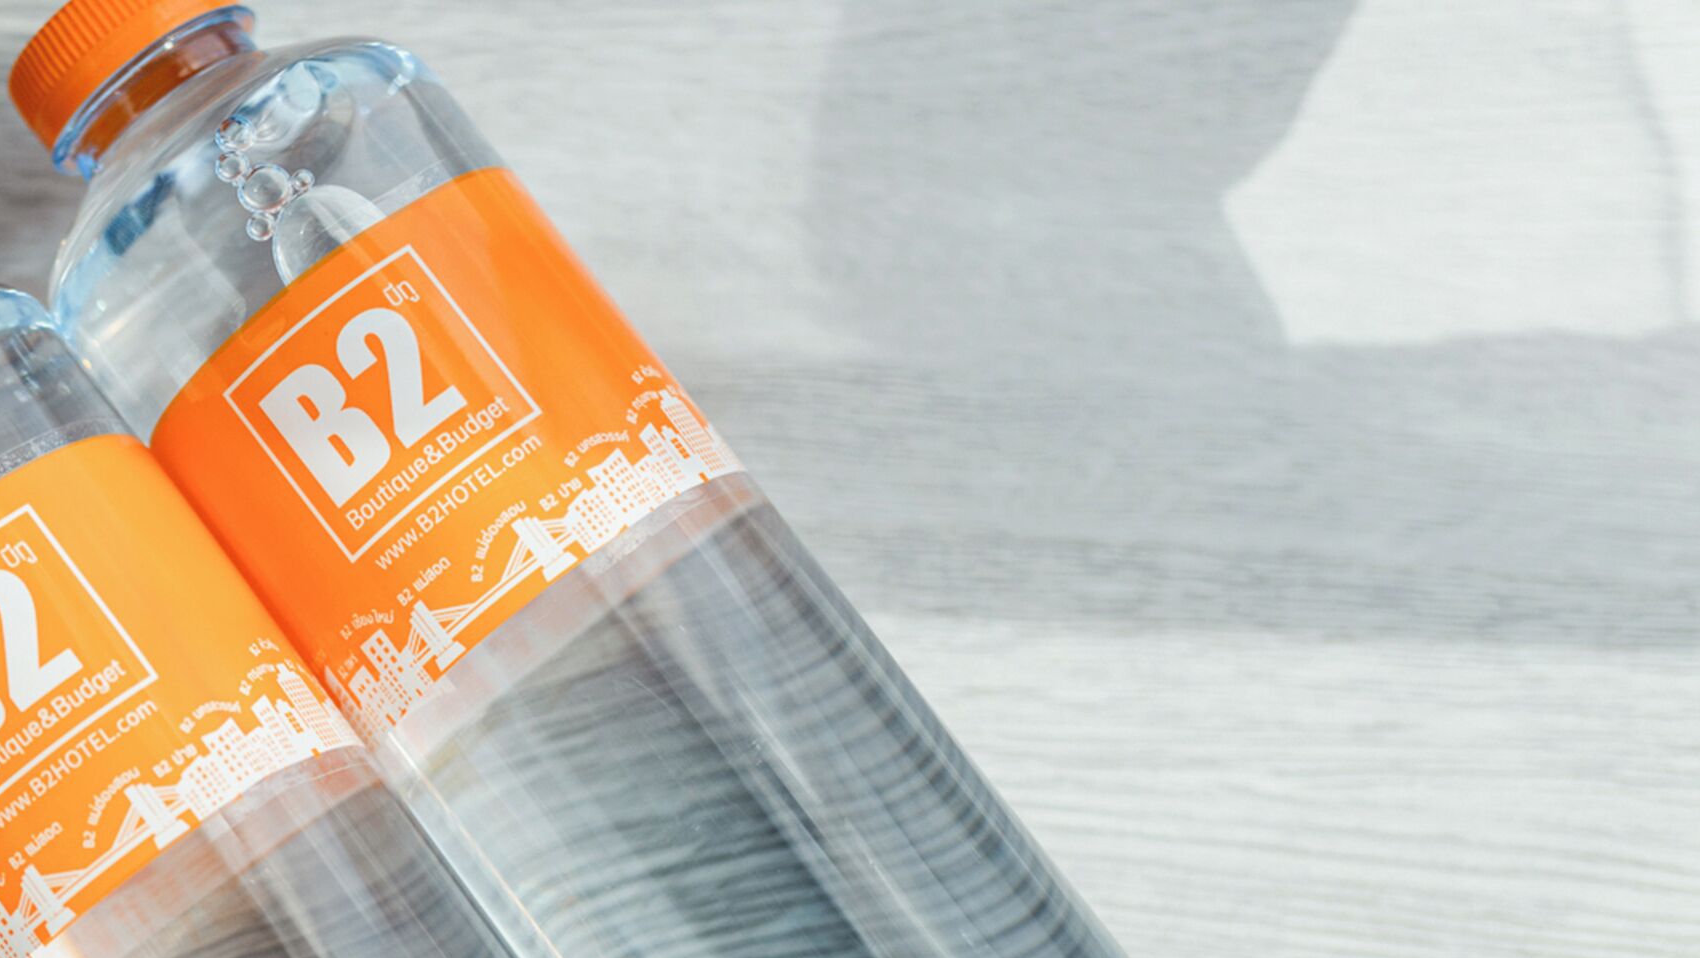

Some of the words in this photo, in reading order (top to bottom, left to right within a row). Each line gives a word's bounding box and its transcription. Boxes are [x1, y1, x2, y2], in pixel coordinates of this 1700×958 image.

[258, 308, 468, 509] B2
[345, 395, 511, 531] Boutique&Budget
[563, 451, 580, 468] B2
[374, 435, 543, 571] www.B2HOTEL.com
[539, 493, 559, 512] B2
[470, 564, 484, 583] B2
[396, 588, 415, 607] B2
[179, 716, 196, 734] B2
[152, 759, 172, 778] B2
[82, 830, 96, 849] B2
[8, 851, 26, 870] B2
